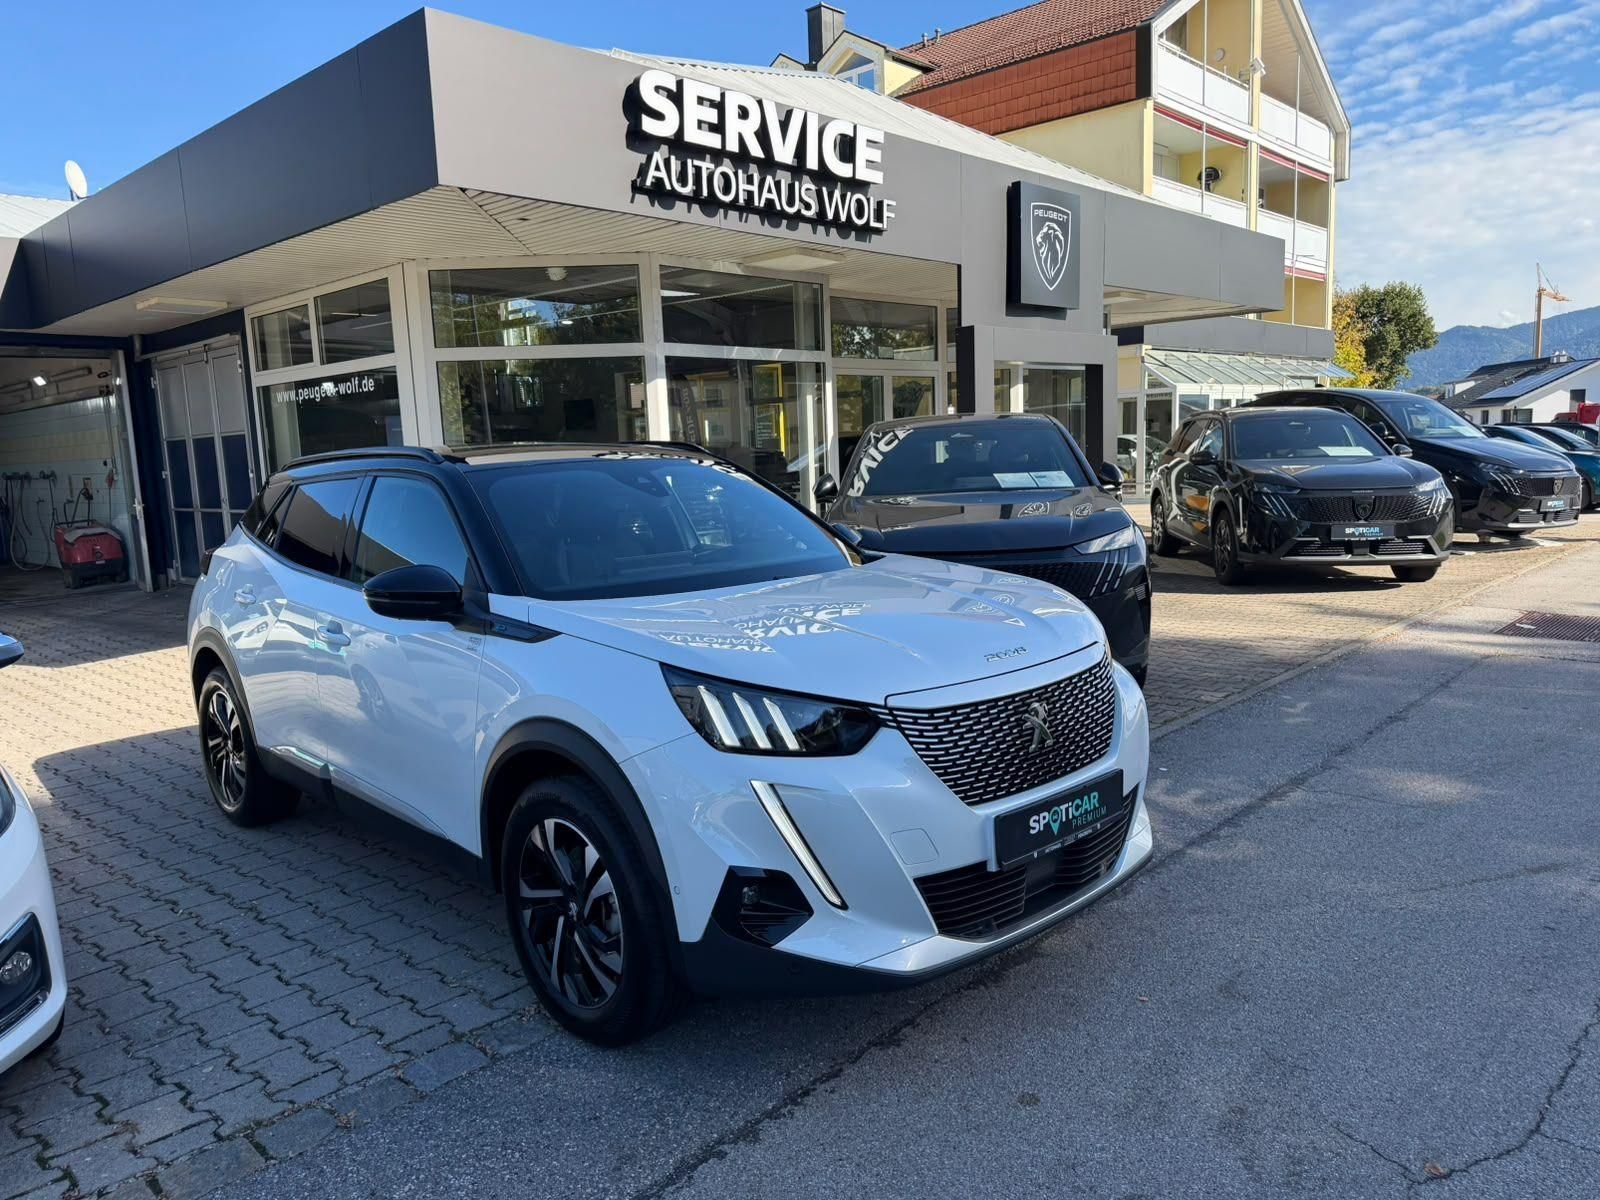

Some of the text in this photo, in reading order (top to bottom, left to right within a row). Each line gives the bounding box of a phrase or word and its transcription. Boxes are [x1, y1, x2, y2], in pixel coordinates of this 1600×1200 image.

[638, 69, 885, 184] SERVICE
[645, 151, 897, 230] AUTOHAUS WOLF
[1033, 208, 1068, 223] PEUGEOT
[983, 646, 1029, 663] 2008
[1072, 805, 1107, 829] PREMIUM
